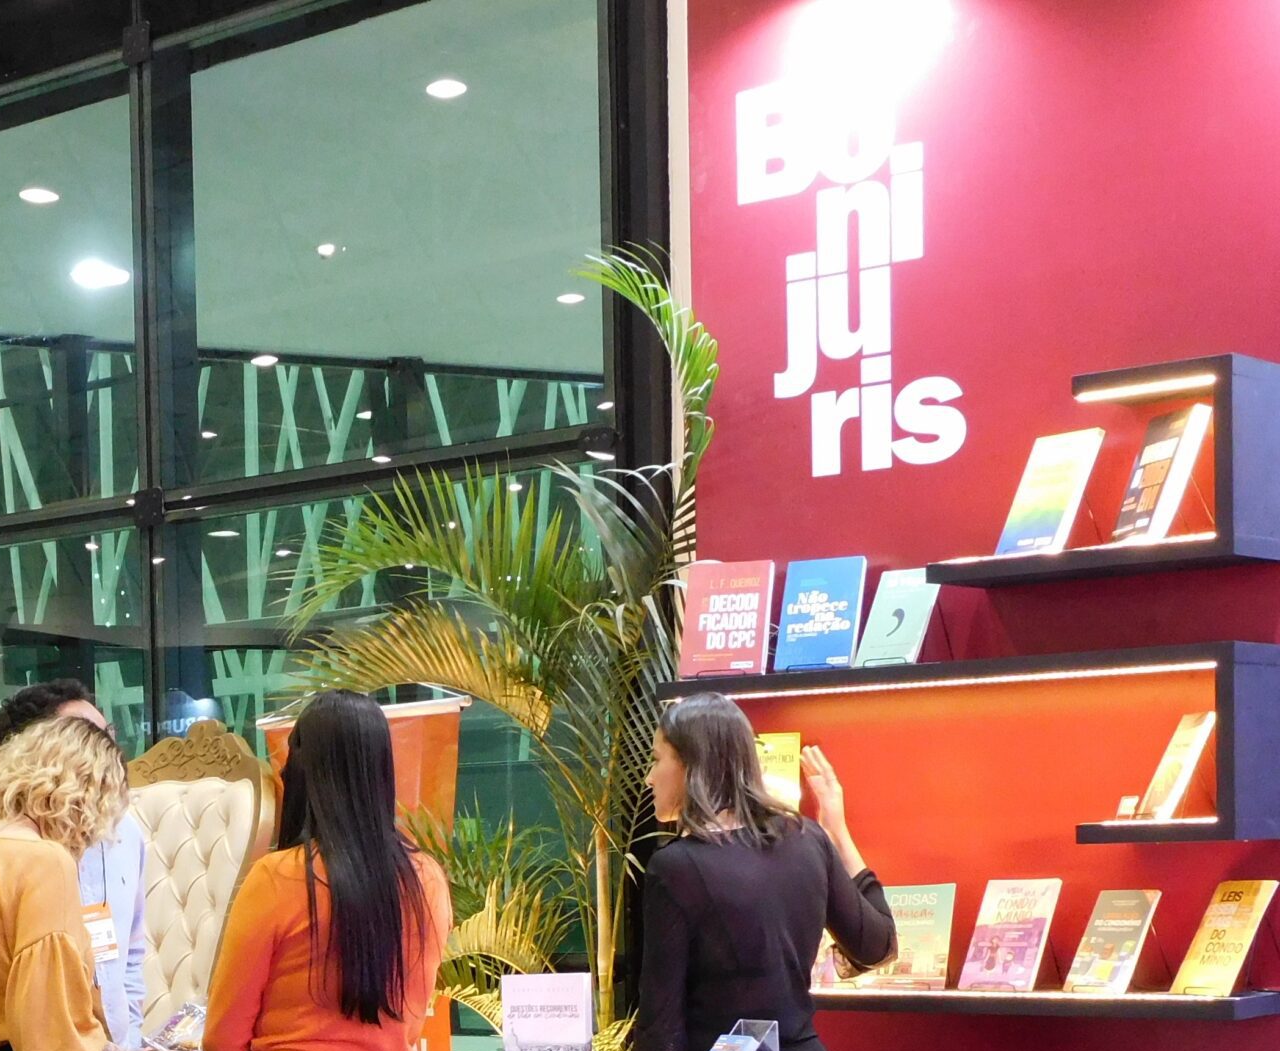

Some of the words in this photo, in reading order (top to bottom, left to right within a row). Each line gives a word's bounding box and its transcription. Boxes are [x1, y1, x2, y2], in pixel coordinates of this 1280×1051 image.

[709, 593, 759, 612] DECODI
[797, 590, 828, 604] Não
[787, 600, 848, 615] tropece
[698, 611, 758, 631] FICADOR
[787, 617, 851, 634] redação
[706, 632, 725, 649] DO
[727, 630, 756, 649] CPC
[890, 893, 938, 906] COISAS
[1221, 890, 1244, 903] LEIS
[1210, 929, 1227, 941] DO
